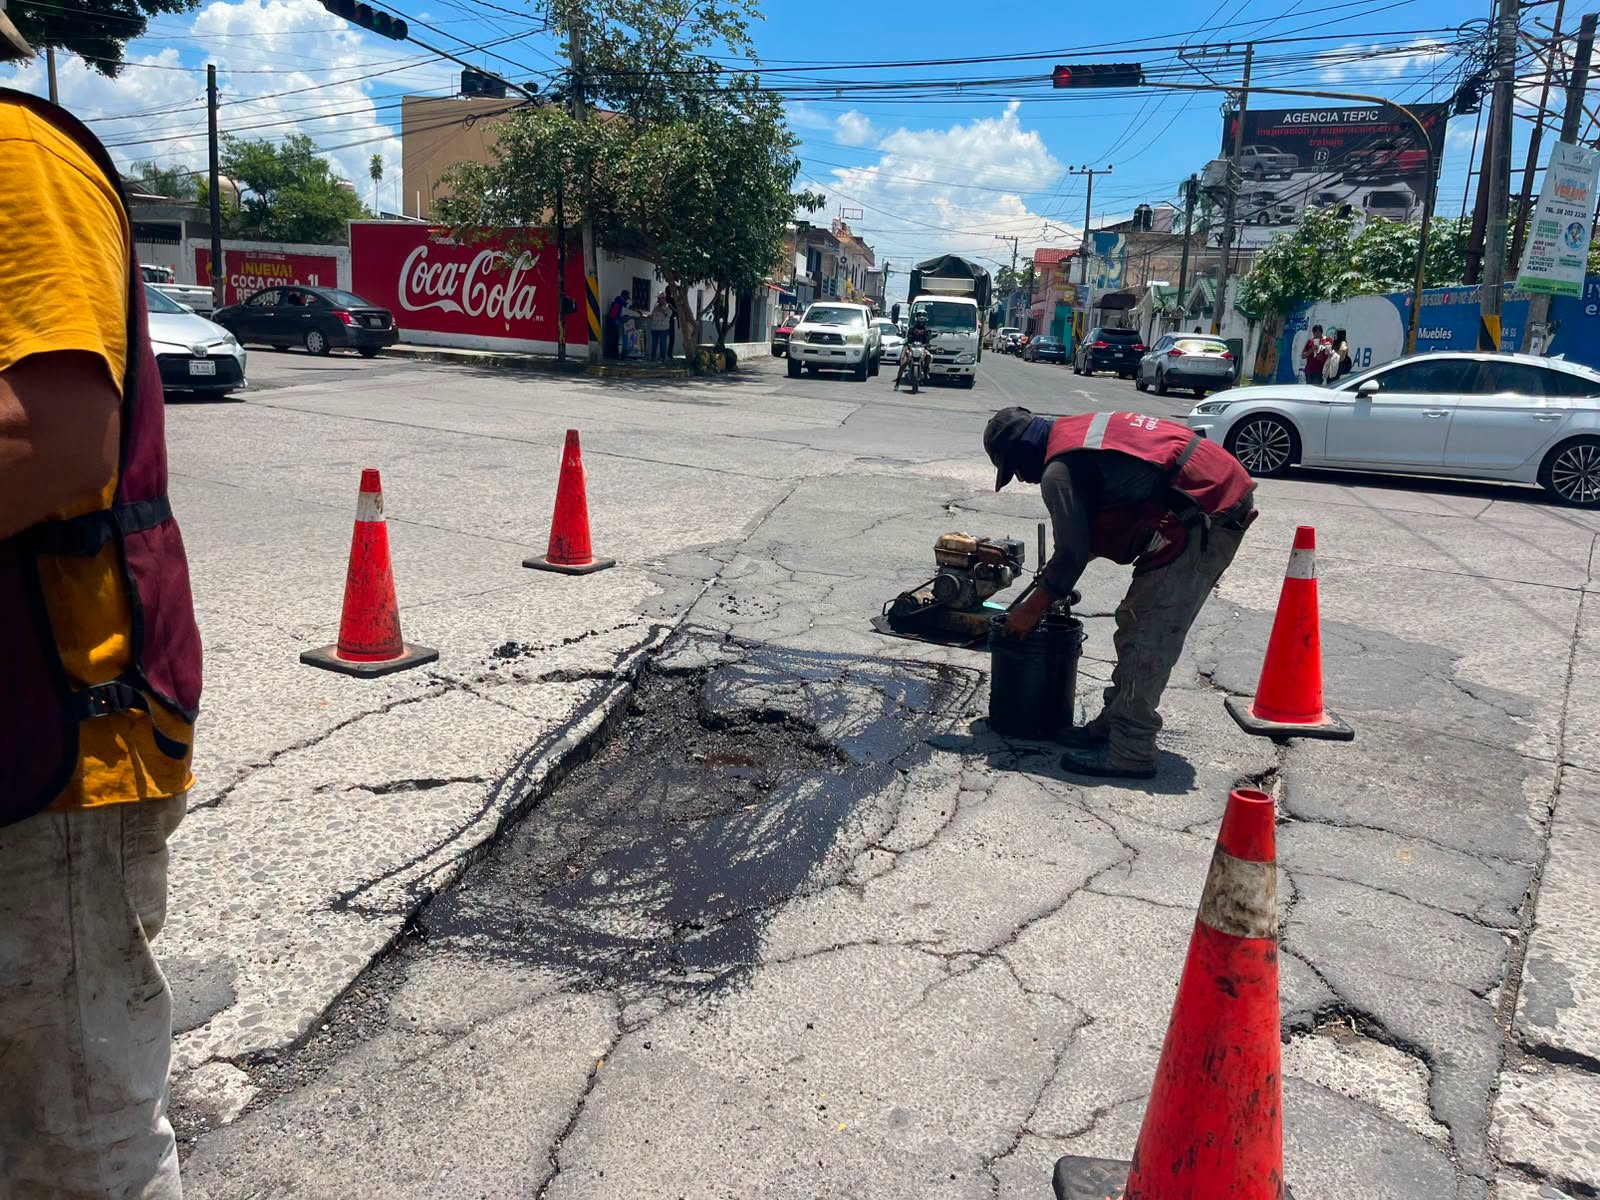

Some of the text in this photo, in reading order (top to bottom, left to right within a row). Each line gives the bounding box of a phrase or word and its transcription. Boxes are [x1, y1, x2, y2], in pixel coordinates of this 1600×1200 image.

[1282, 110, 1379, 124] AGENCIA TEPIC
[231, 274, 265, 290] COCA
[398, 245, 541, 320] Coca-Cola
[1417, 327, 1452, 339] Muebles
